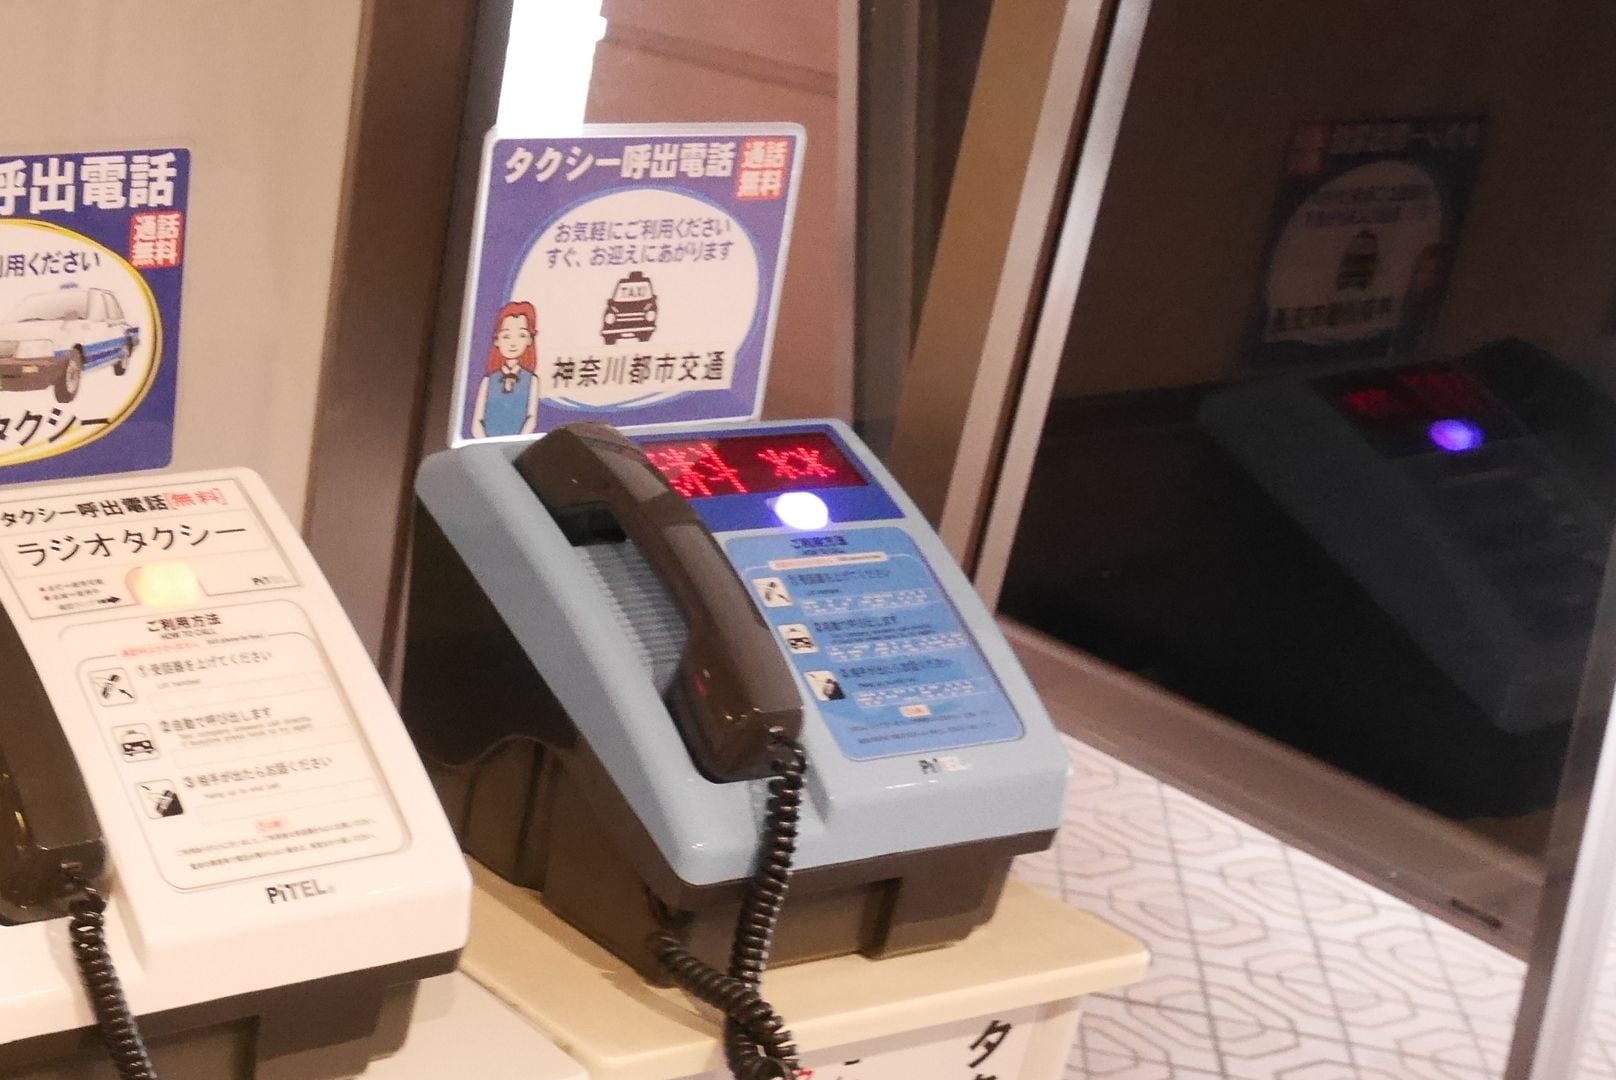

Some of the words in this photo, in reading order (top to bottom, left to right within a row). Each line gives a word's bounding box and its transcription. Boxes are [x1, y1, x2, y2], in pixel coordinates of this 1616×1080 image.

[504, 140, 736, 184] タクシー呼出電話
[742, 139, 788, 168] 通話
[736, 168, 783, 197] 無料
[133, 213, 181, 240] 通話
[554, 217, 732, 244] お気軽にご利用ください
[131, 239, 178, 267] 無料
[546, 241, 734, 269] すぐ、お迎えにあがります
[552, 350, 726, 389] 神奈川都市交通
[17, 523, 247, 567] ラジオタクシー
[146, 613, 222, 633] ご利用方法
